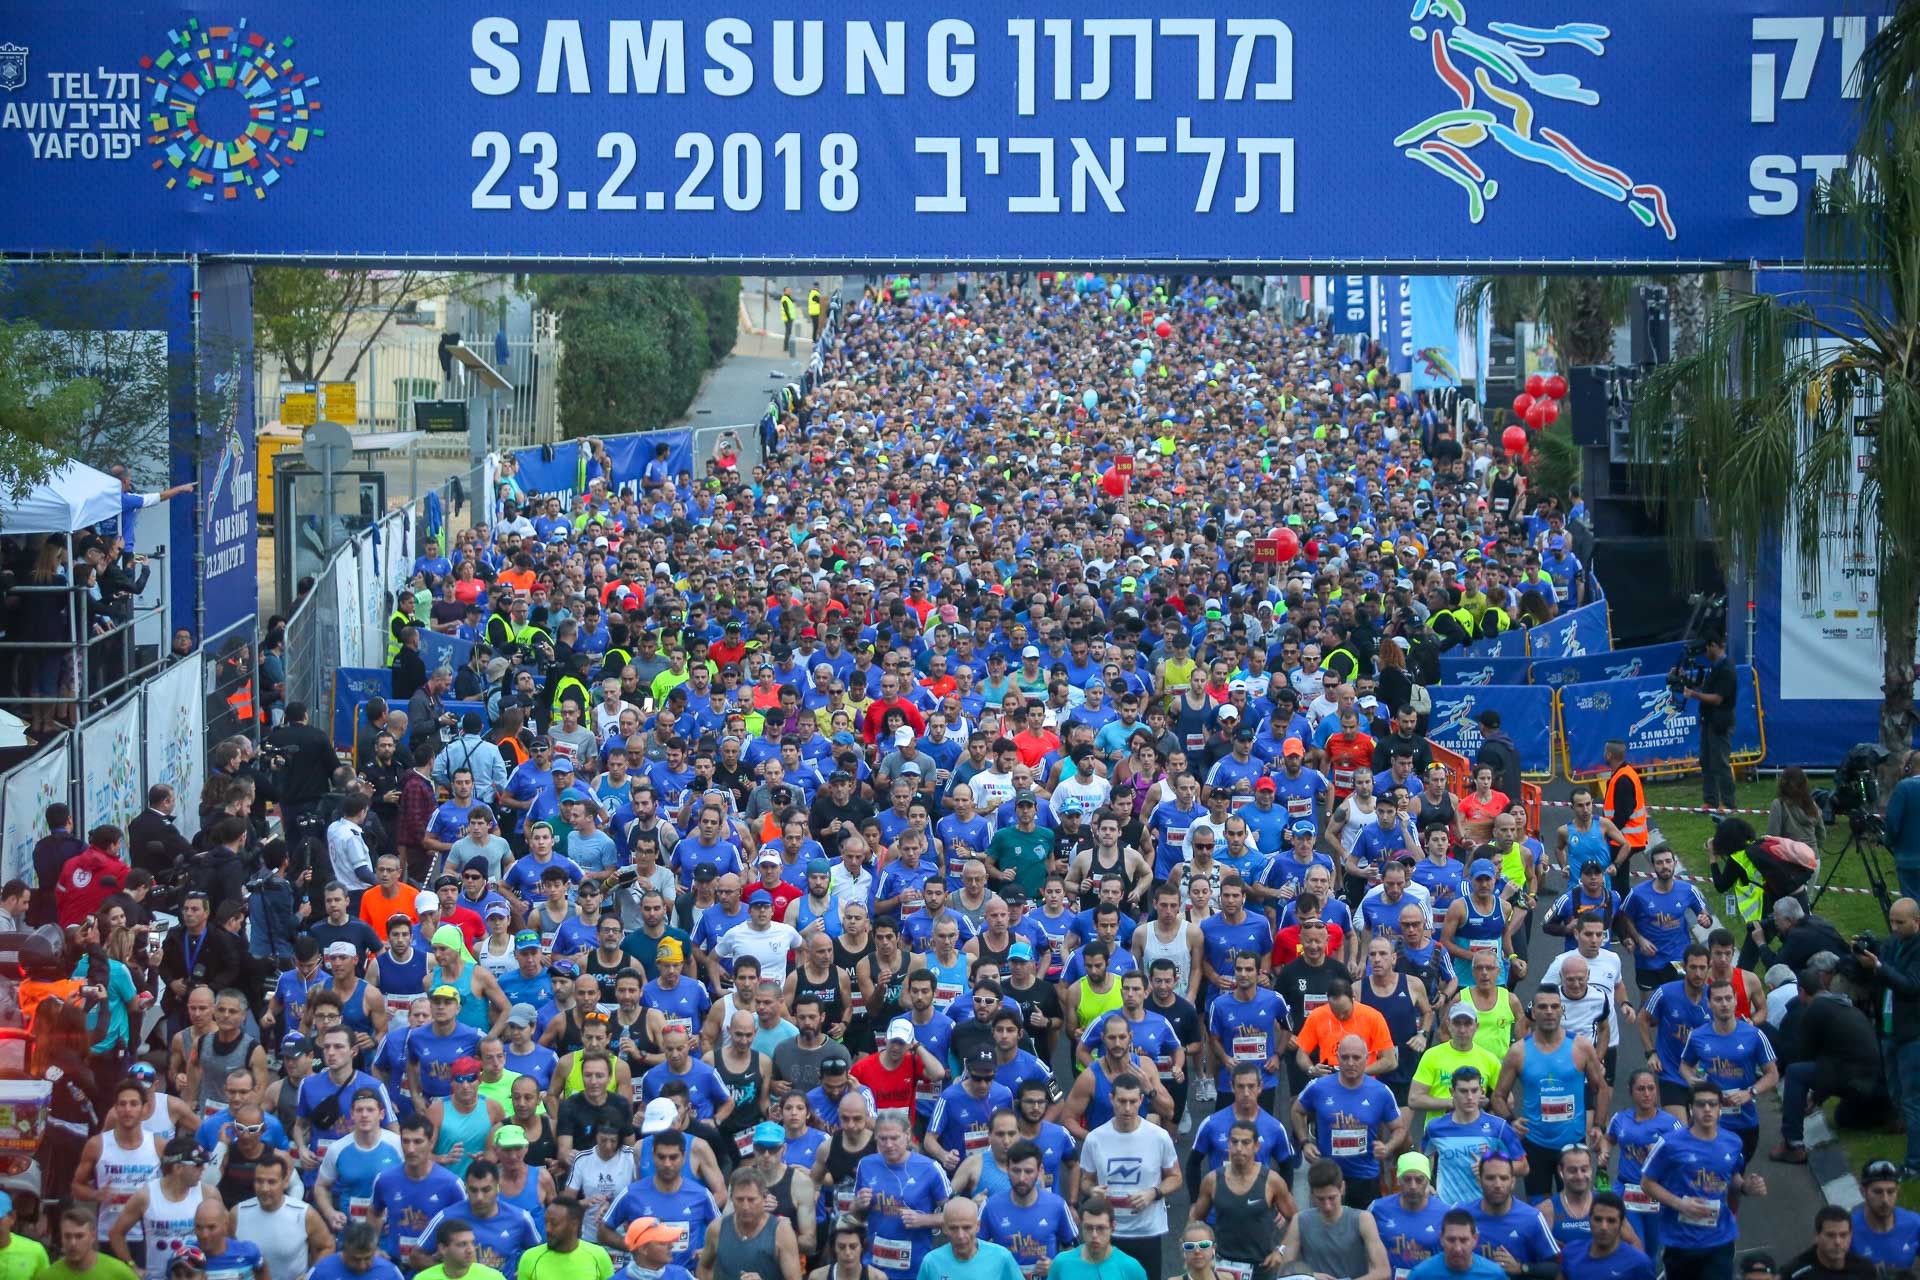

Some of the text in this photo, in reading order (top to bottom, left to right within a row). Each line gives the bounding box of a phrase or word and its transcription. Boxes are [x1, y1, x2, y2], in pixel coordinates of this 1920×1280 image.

[470, 17, 976, 97] SAMSUNG
[1008, 18, 1293, 115] מרתון
[48, 73, 98, 99] TEL
[99, 66, 140, 99] תל
[2, 103, 66, 128] AVIV
[69, 103, 141, 129] אביב
[28, 133, 99, 159] YAFO
[101, 133, 141, 159] יפו
[471, 131, 858, 212] 23.2.2018
[215, 509, 248, 546] SAMSUNG
[1640, 727, 1690, 740] SAMSUNG
